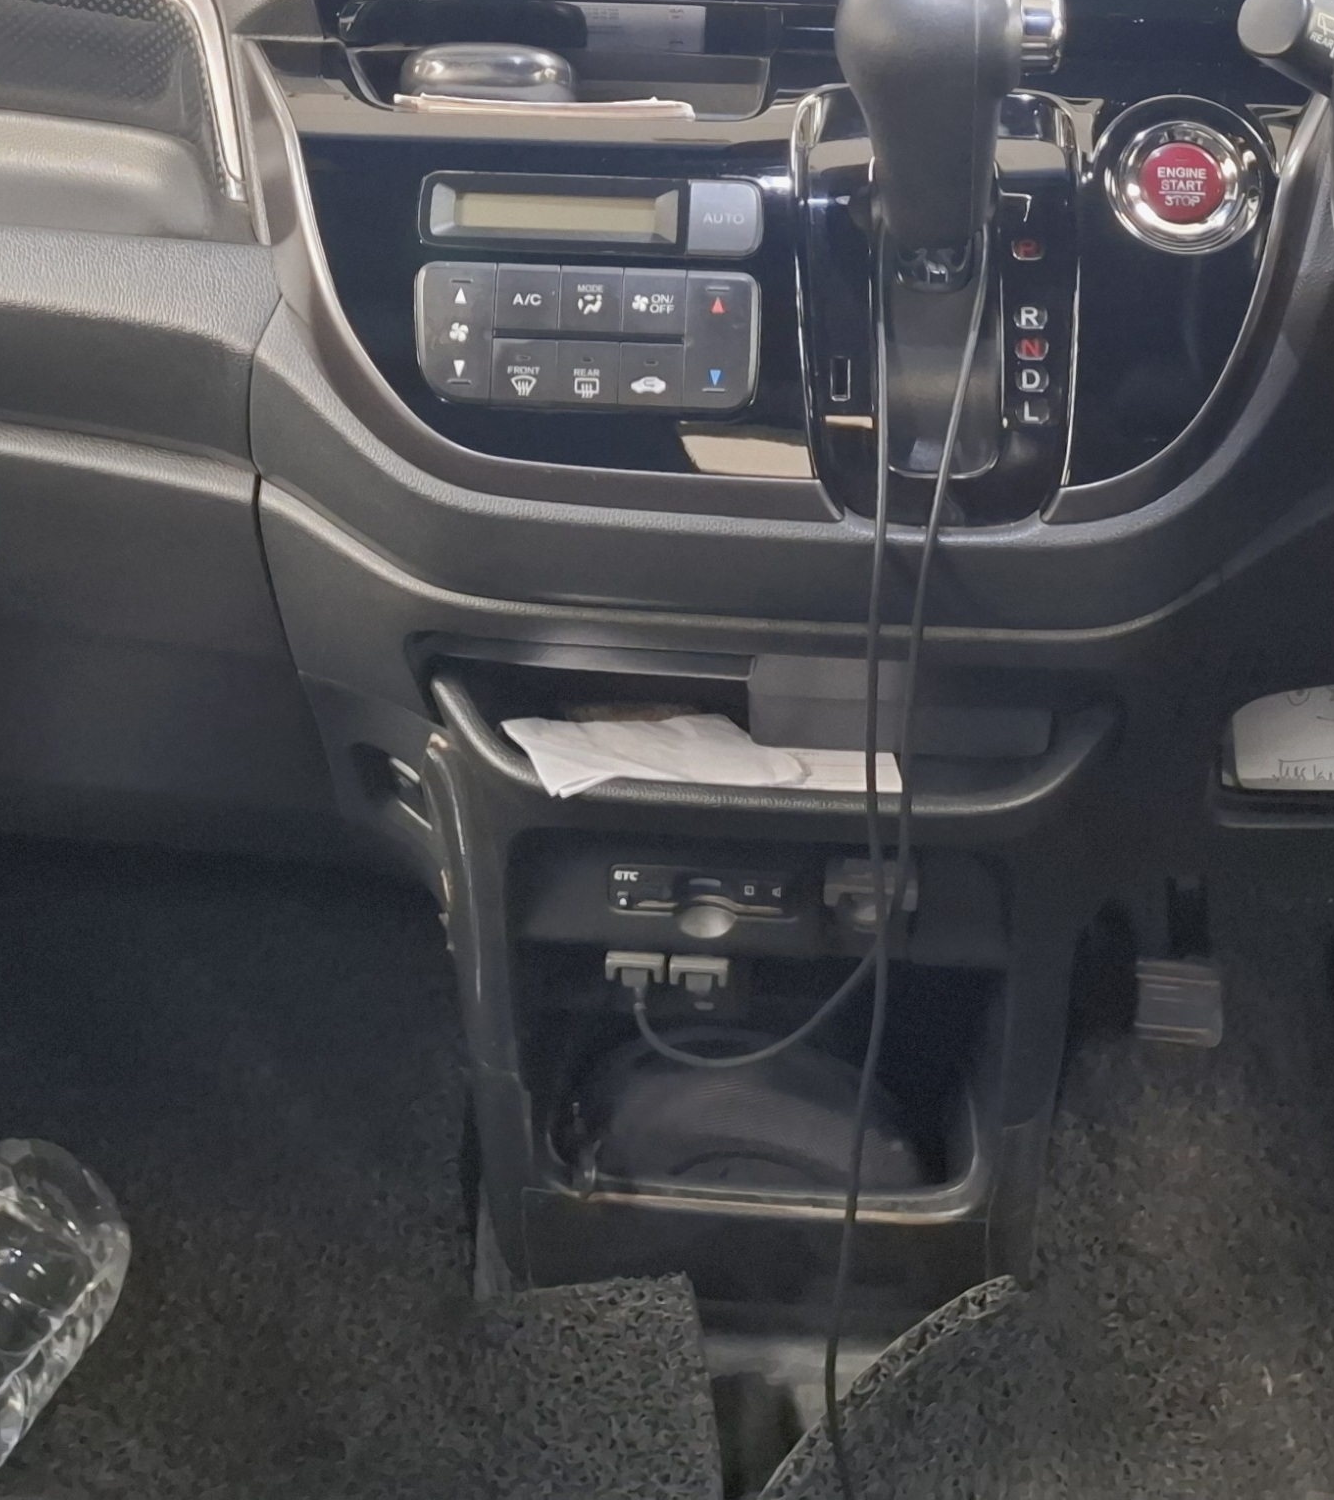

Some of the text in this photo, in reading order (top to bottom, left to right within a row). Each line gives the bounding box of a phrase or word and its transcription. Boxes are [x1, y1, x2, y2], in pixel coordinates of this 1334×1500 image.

[1310, 31, 1334, 49] REAR
[1157, 166, 1208, 179] ENGINE
[1160, 179, 1204, 191] START
[1164, 194, 1201, 207] STOP
[703, 212, 745, 225] AUTO
[577, 284, 604, 294] MODE
[512, 293, 542, 306] A/C
[651, 294, 674, 304] ON/
[649, 304, 675, 314] OFF
[1020, 306, 1038, 326] R
[1021, 340, 1040, 357] N
[507, 366, 540, 375] FRONT
[573, 368, 600, 377] REAR
[1021, 369, 1041, 389] D
[1023, 400, 1039, 422] L
